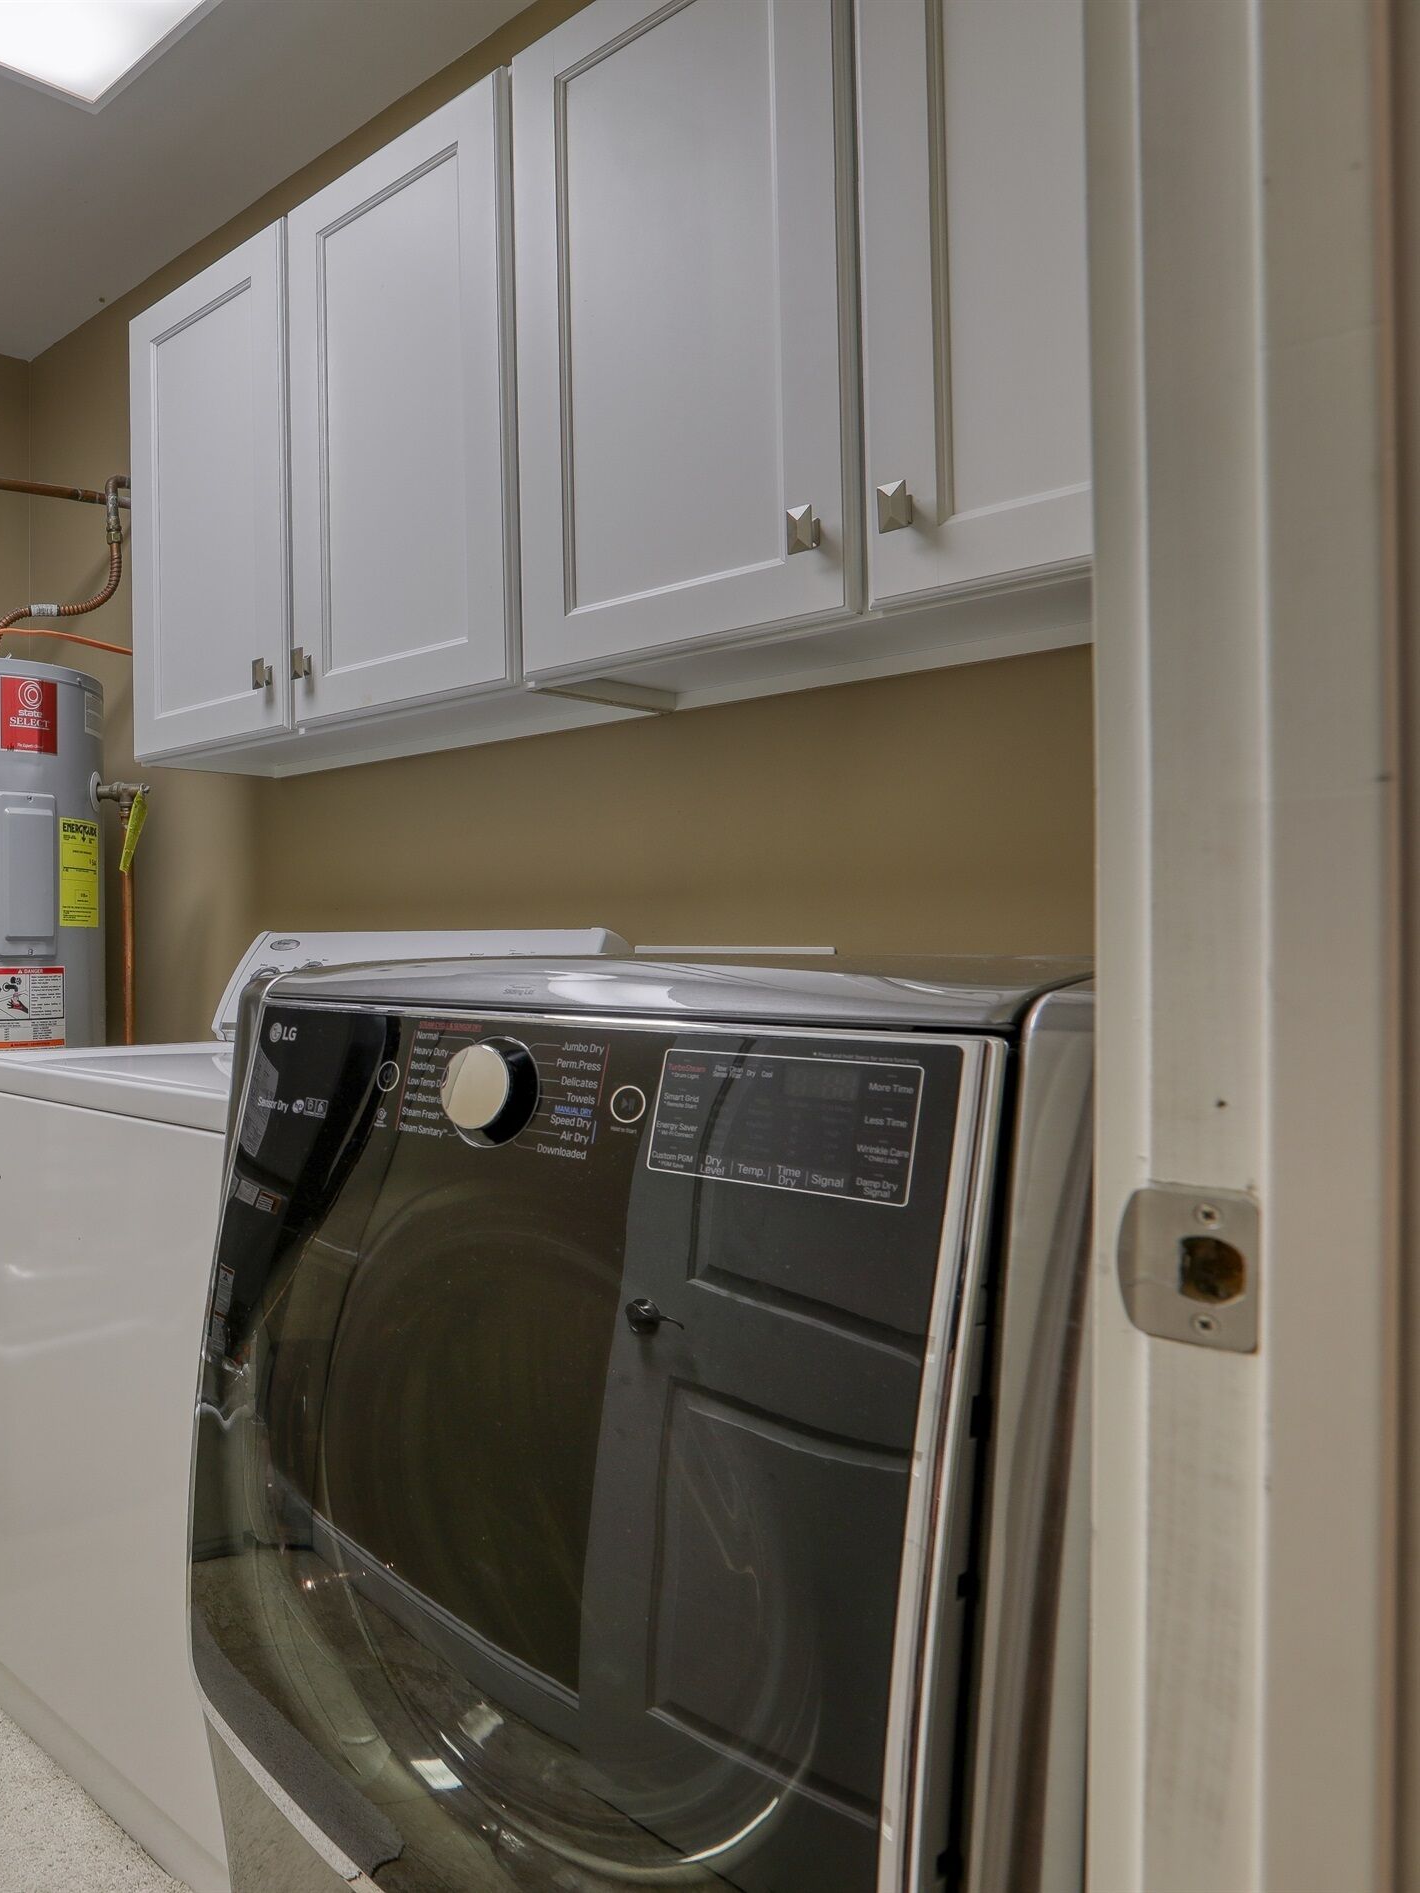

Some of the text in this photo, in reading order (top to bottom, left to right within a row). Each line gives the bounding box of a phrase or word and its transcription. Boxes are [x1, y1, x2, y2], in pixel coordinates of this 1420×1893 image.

[9, 716, 50, 728] SELECT
[282, 1026, 298, 1041] LG
[416, 1031, 439, 1041] Normal
[413, 1046, 448, 1057] Heavy Duty
[562, 1041, 605, 1056] Jumbo Dry
[410, 1061, 435, 1073] Bedding
[746, 1069, 756, 1078] Dry
[761, 1070, 773, 1078] Cool
[407, 1076, 420, 1085] Low
[420, 1078, 436, 1088] Temp
[561, 1076, 598, 1089] Delicates
[869, 1082, 914, 1094] More Time
[566, 1092, 596, 1105] Towels
[664, 1092, 699, 1103] Smart Grid
[277, 1100, 289, 1114] Dry
[401, 1106, 421, 1117] Steam
[554, 1105, 593, 1117] MANUAL DRY
[399, 1121, 418, 1132] Steam
[550, 1114, 592, 1131] Speed Dry
[656, 1120, 698, 1132] Energy Saver
[864, 1115, 908, 1128] Less Time
[560, 1131, 590, 1145] Air Dry
[537, 1143, 587, 1160] Downloaded
[652, 1150, 693, 1163] Custom PGM
[856, 1144, 910, 1159] Wrinkle Care
[705, 1155, 722, 1167] Dry
[700, 1164, 725, 1176] Level
[738, 1163, 766, 1178] Temp.
[777, 1165, 801, 1177] Time
[778, 1175, 796, 1188] Dry
[811, 1174, 844, 1188] Signal
[855, 1177, 898, 1193] Damp Dry
[863, 1186, 891, 1199] Signal
